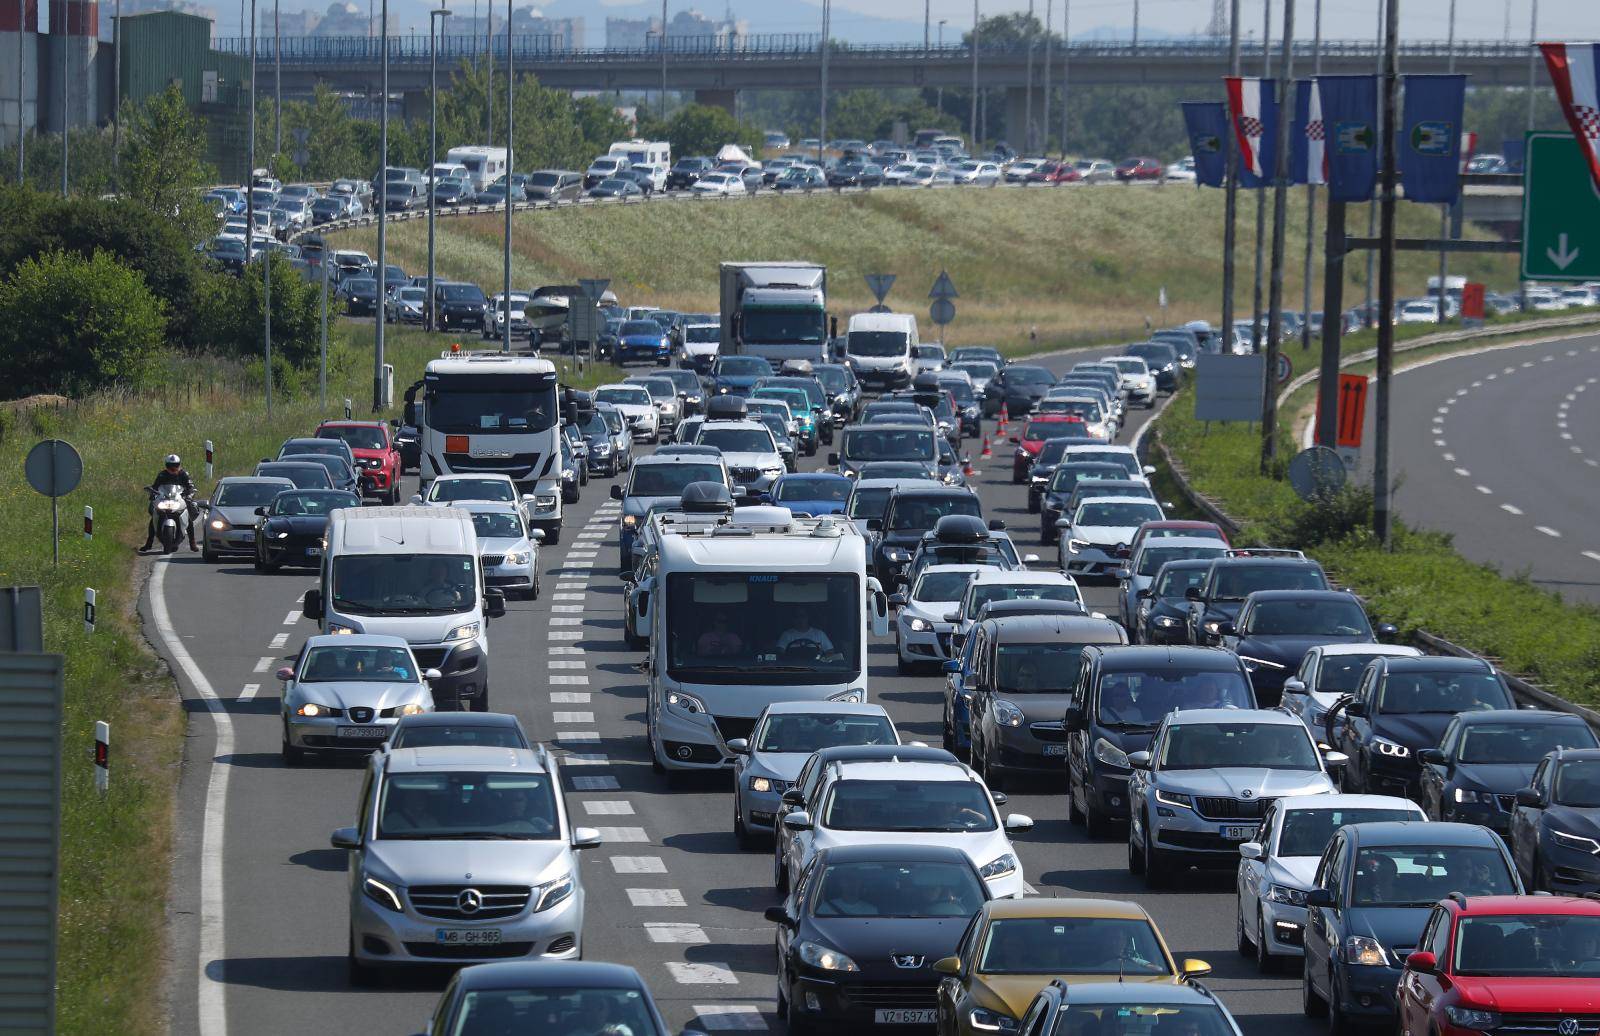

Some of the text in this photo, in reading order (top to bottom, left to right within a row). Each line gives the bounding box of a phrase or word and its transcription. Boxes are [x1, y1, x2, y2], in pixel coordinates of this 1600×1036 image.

[445, 931, 500, 942] MB GH-965
[883, 1011, 896, 1023] VZ
